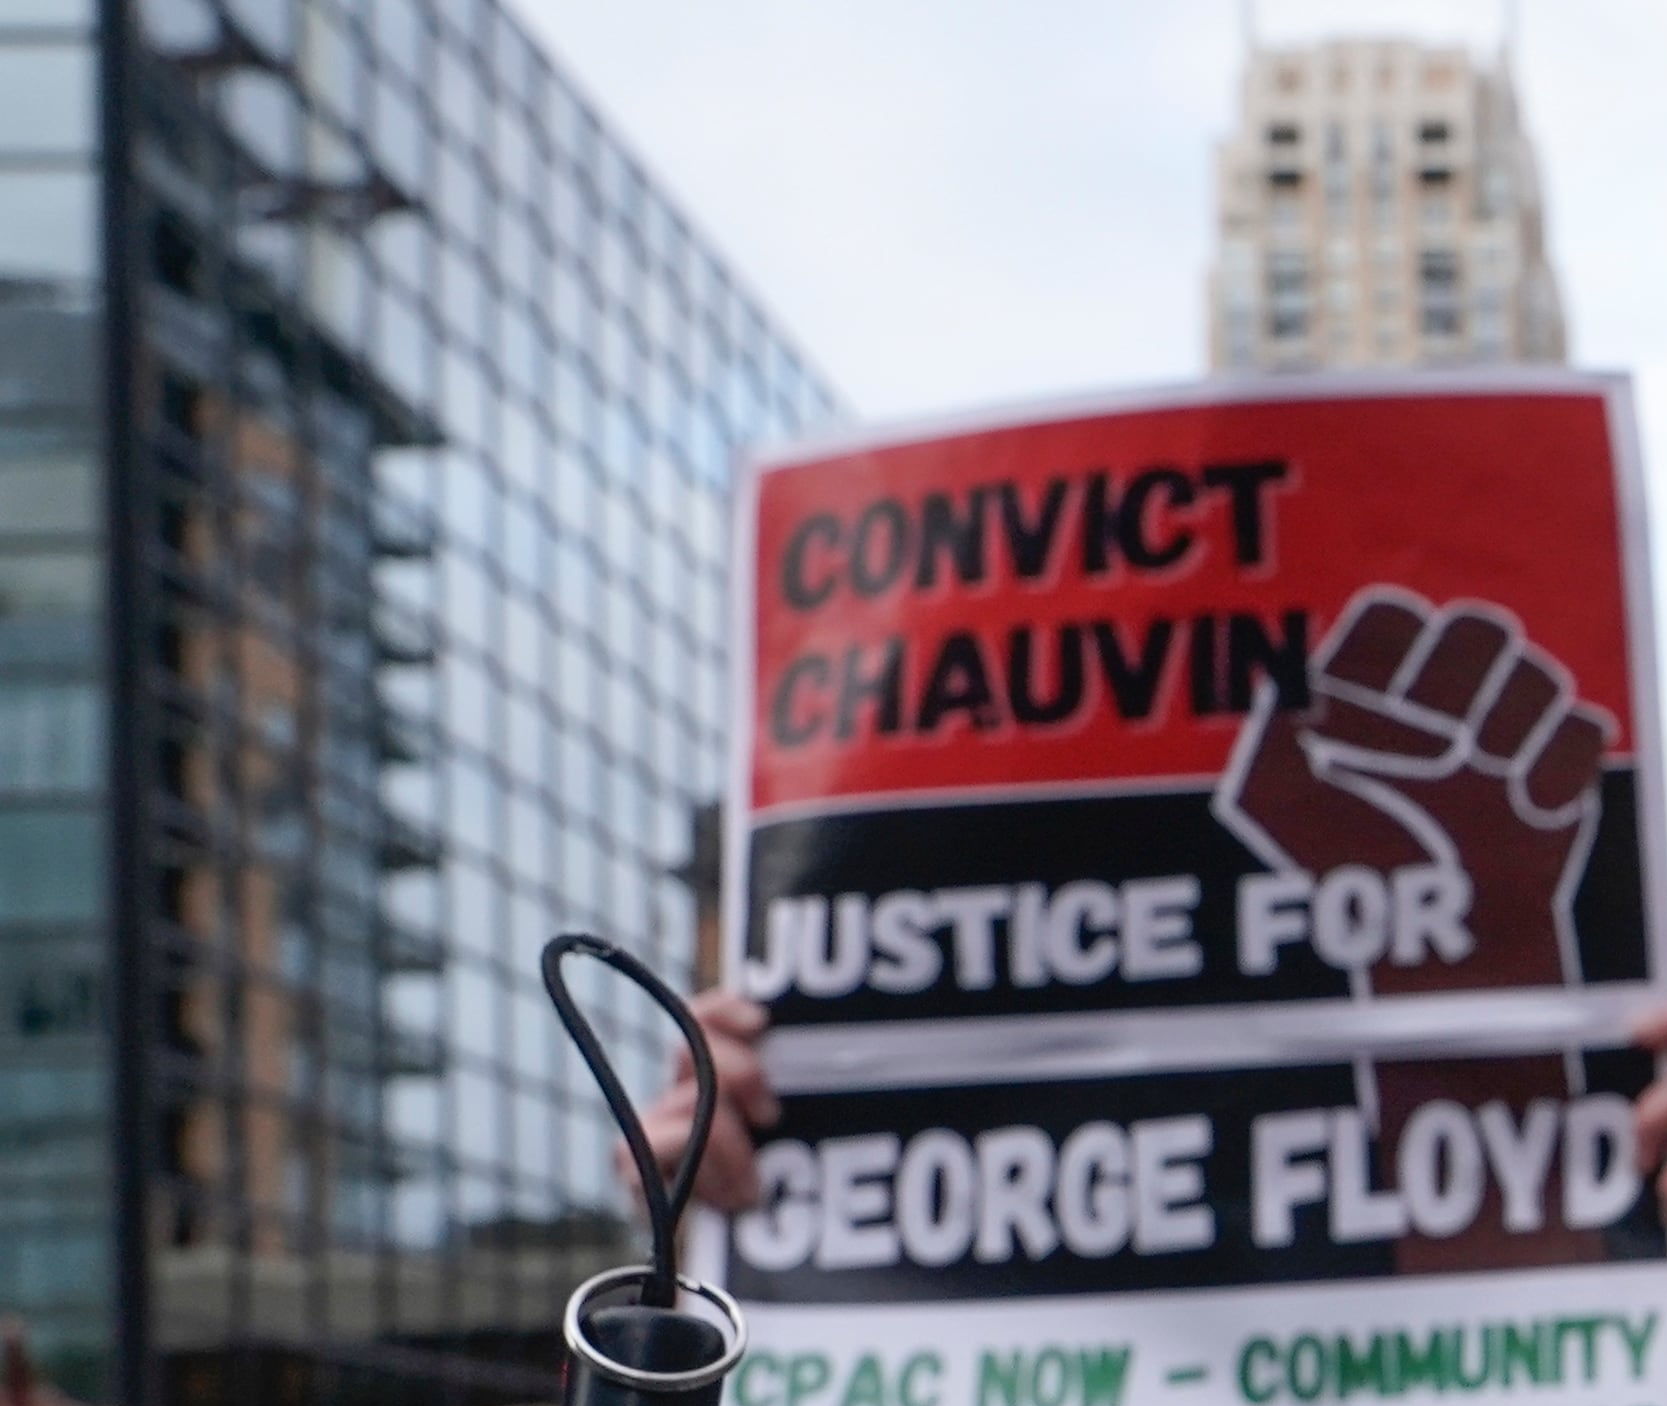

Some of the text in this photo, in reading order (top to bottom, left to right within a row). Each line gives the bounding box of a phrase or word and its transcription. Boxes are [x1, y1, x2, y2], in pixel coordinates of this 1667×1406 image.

[778, 460, 1293, 610] CONVICT
[769, 611, 1312, 747] CHAUVIN
[746, 866, 1474, 1000] JUSTICE FOR
[735, 1093, 1642, 1271] GEORGE FLOYD
[1238, 1313, 1660, 1403] COMMUNITY
